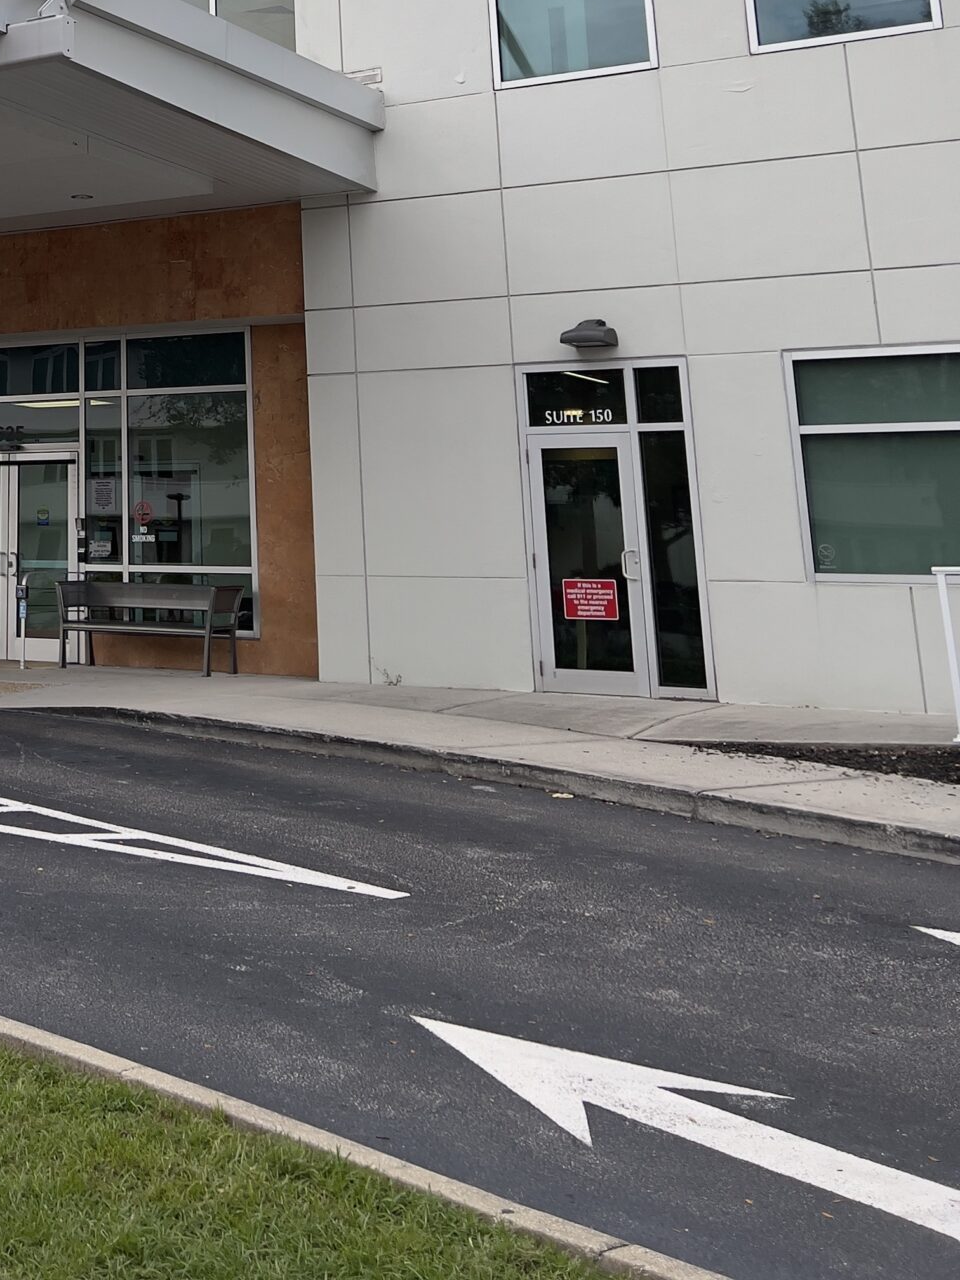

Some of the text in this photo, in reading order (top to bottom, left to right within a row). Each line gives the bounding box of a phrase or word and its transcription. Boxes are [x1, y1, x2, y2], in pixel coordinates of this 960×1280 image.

[545, 408, 613, 424] SUITE 150
[131, 534, 156, 542] SMOKING
